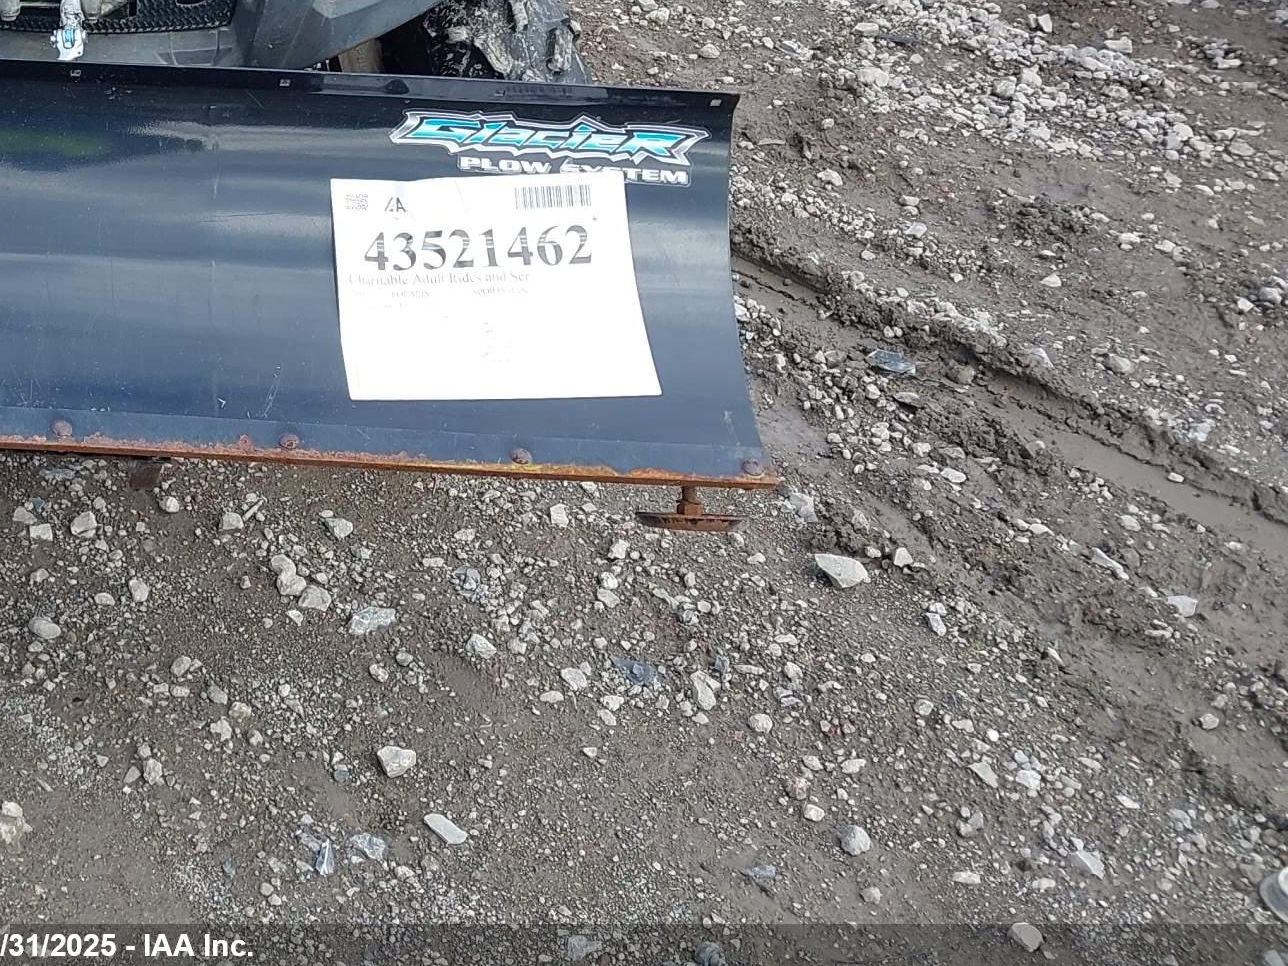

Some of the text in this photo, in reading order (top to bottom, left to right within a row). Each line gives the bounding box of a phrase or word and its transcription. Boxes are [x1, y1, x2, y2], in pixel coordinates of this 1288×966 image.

[459, 156, 551, 173] PLOW
[364, 224, 593, 271] 43521462
[412, 273, 444, 284] Adult
[449, 273, 482, 284] Rides
[485, 272, 507, 282] and
